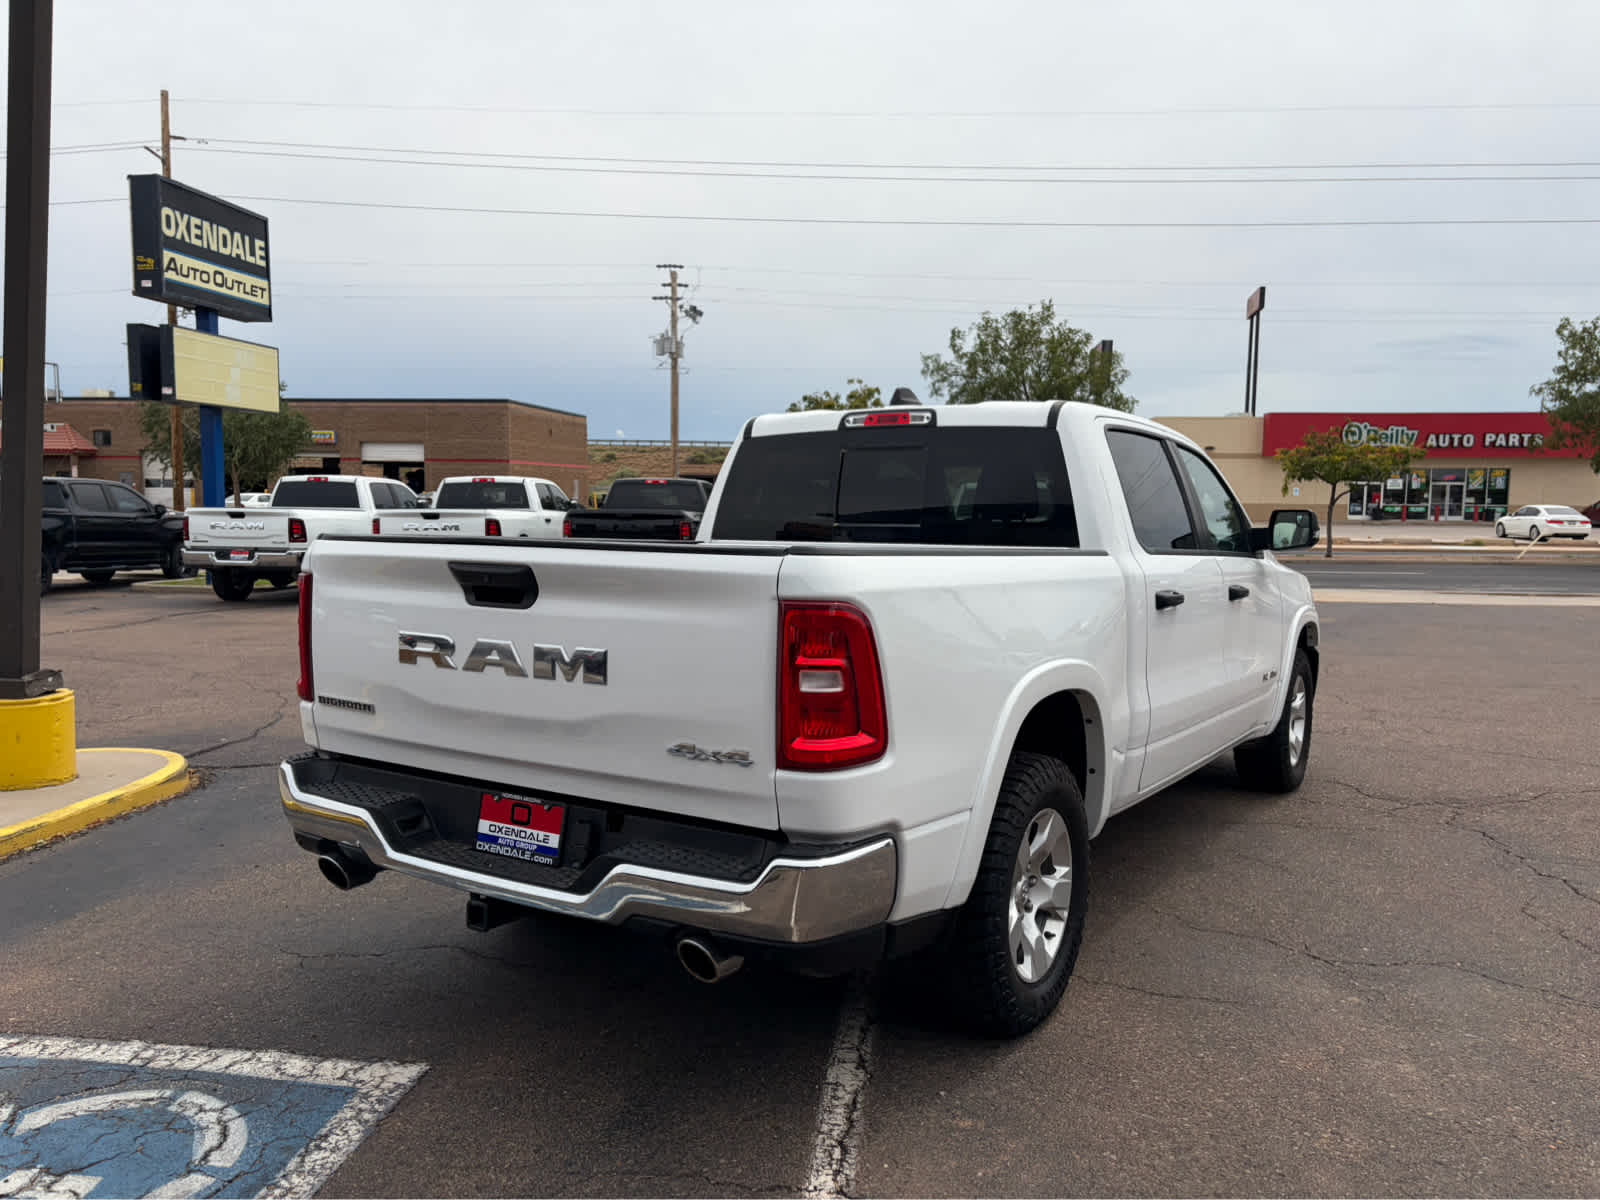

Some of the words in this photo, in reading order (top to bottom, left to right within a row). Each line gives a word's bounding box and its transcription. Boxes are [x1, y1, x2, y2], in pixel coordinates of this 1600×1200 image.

[161, 206, 267, 268] OXENDALE
[1426, 433, 1475, 448] AUTO
[209, 521, 265, 531] RAM
[398, 630, 609, 686] RAM
[488, 823, 552, 845] OXENDALE
[497, 838, 515, 848] AUTO
[515, 841, 538, 852] GROUP
[476, 842, 554, 866] OXENDALE.com
